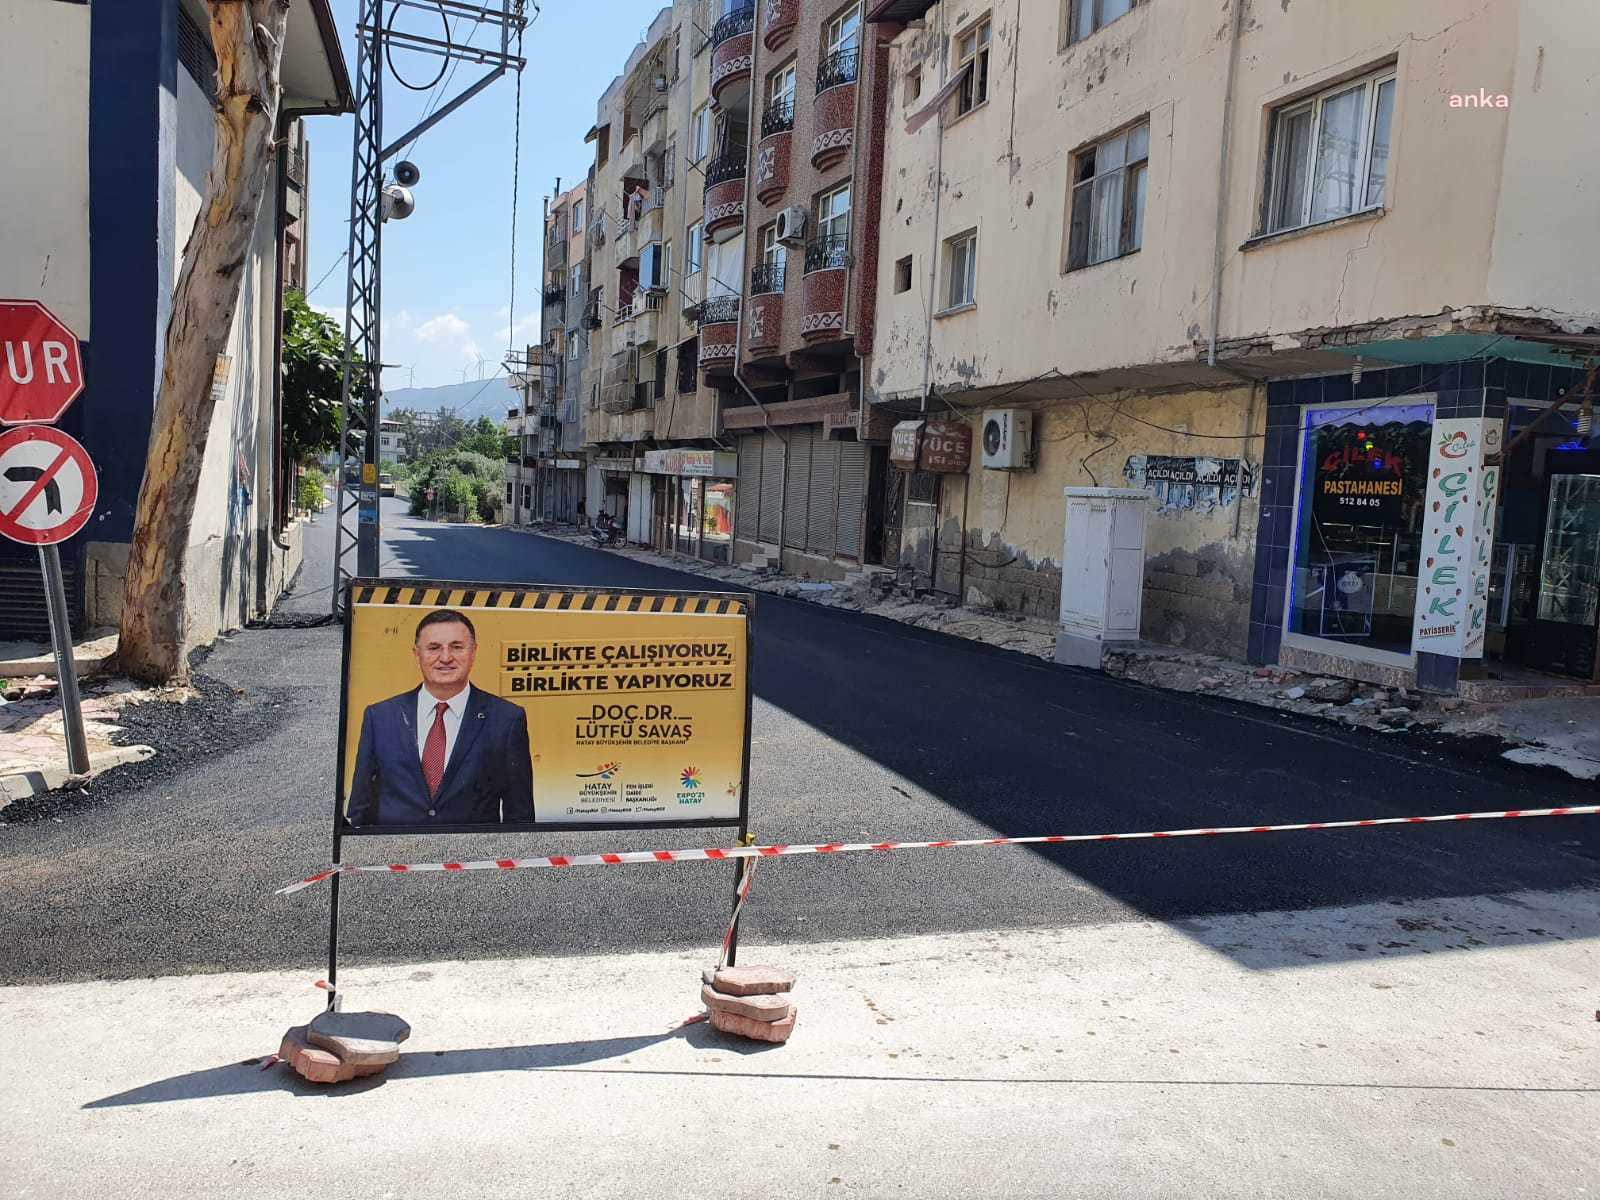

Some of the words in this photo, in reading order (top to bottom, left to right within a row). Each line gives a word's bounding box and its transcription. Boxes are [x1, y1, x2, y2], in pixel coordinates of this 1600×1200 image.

[894, 430, 915, 445] YÜCE
[916, 436, 966, 454] YÜCE
[1147, 469, 1169, 480] AÇILDI
[1170, 471, 1194, 482] AÇILDI
[1324, 479, 1402, 495] PASTAHANESİ
[1339, 497, 1354, 505] 512
[1356, 498, 1367, 506] 84
[1369, 499, 1380, 507] 05
[507, 643, 597, 662] BİRLİKTE
[601, 643, 732, 664] ÇALIŞIYORUZ,
[511, 672, 609, 692] BİRLİKTE
[614, 673, 732, 690] YAPIYORUZ
[592, 704, 677, 723] DOÇ.DR.
[576, 721, 634, 739] LÜTFÜ
[638, 724, 693, 741] SAVAŞ
